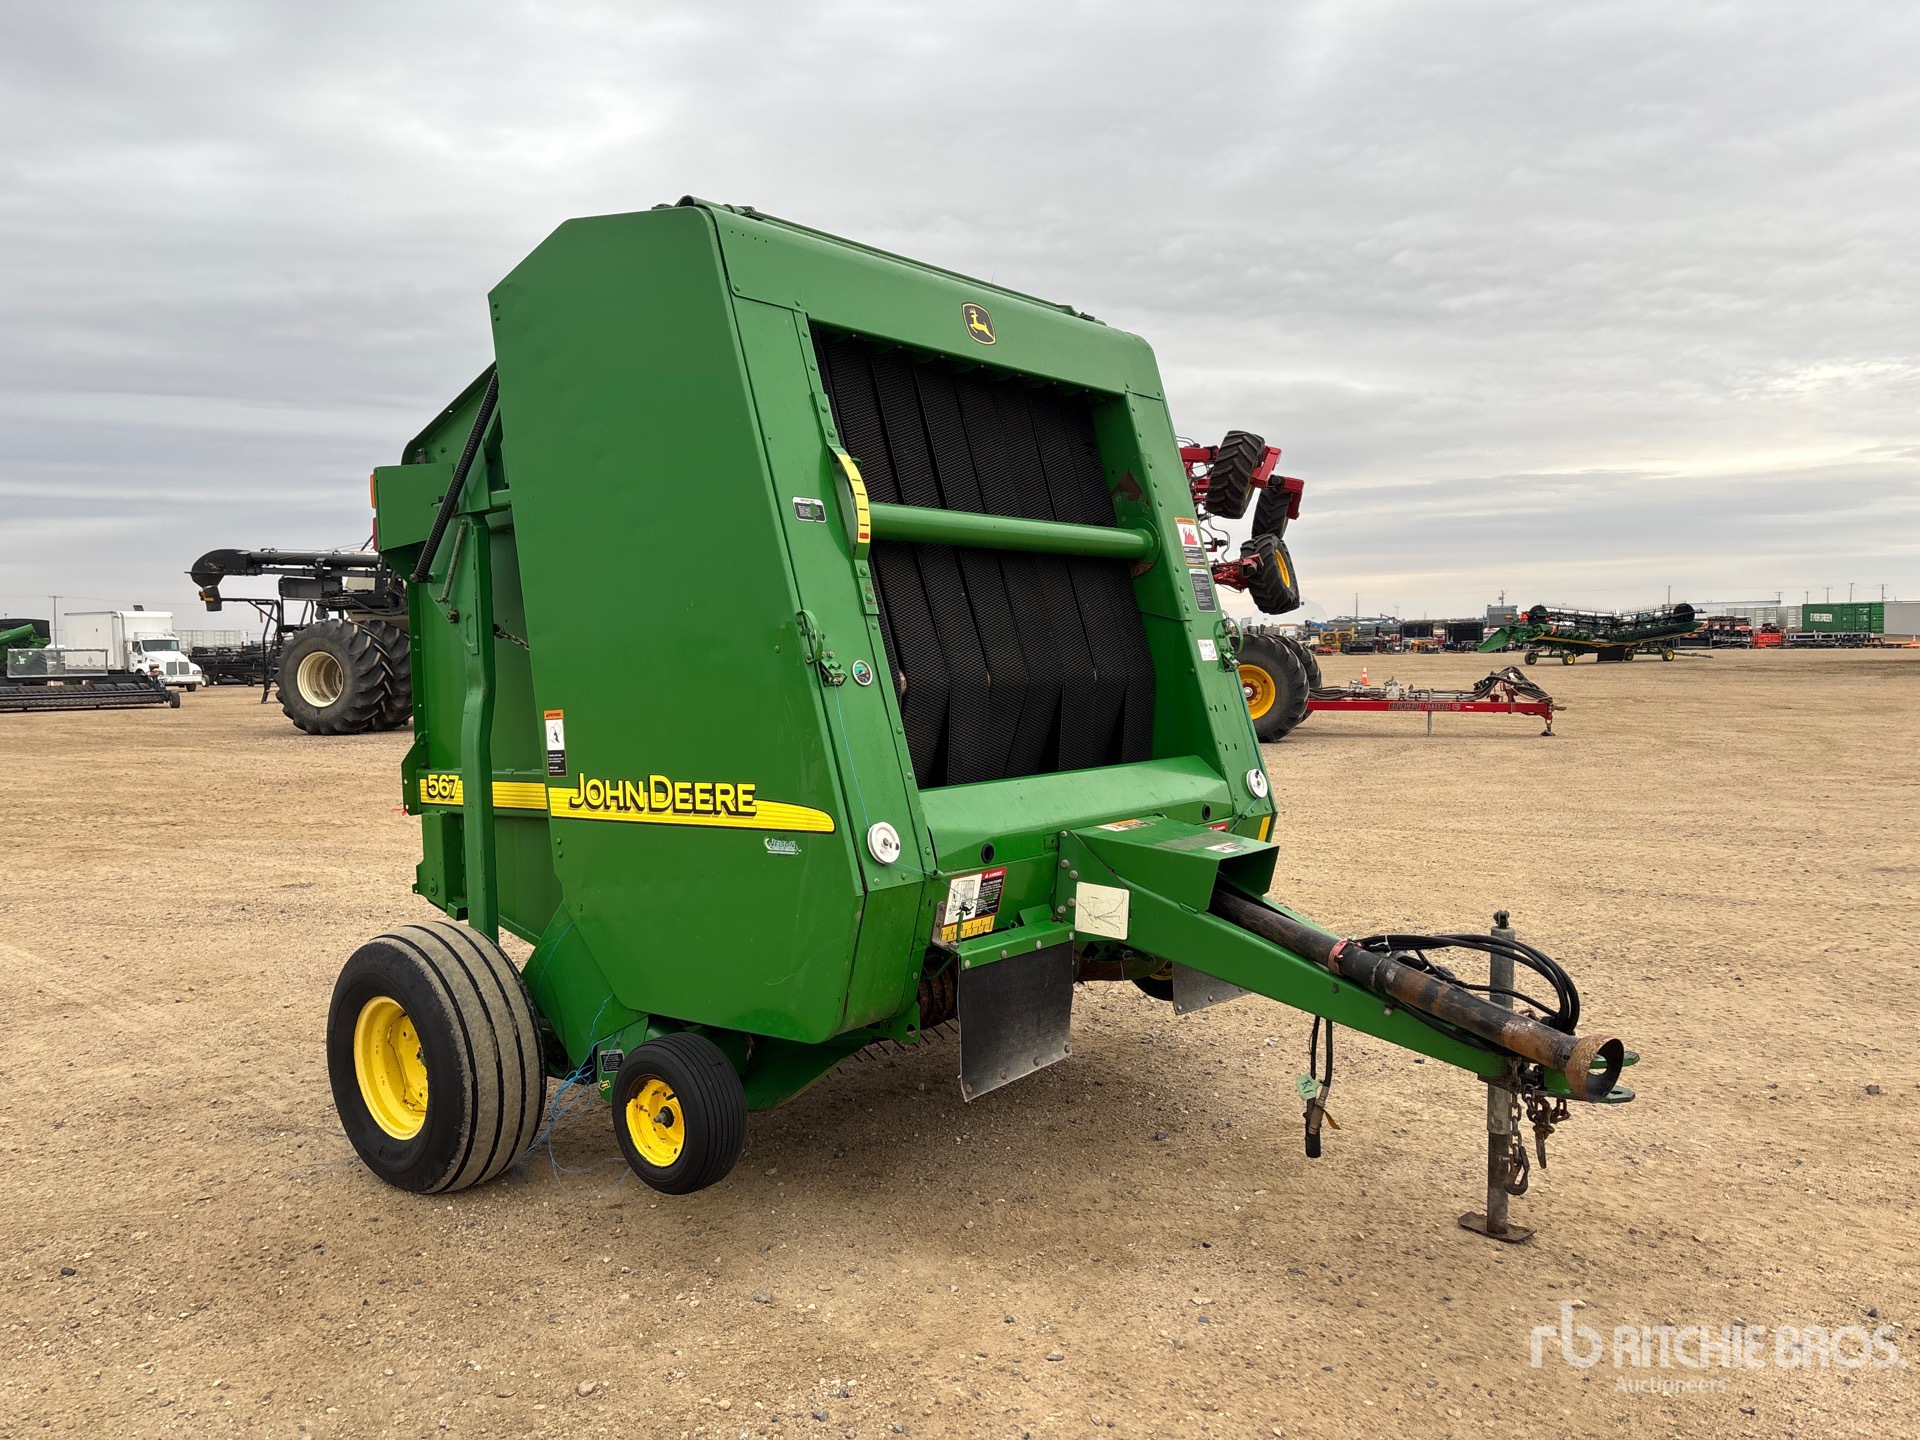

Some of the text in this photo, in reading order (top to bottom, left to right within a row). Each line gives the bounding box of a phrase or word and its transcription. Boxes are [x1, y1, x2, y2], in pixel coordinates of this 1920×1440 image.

[427, 774, 460, 799] 567
[570, 772, 757, 817] JOHN DEERE
